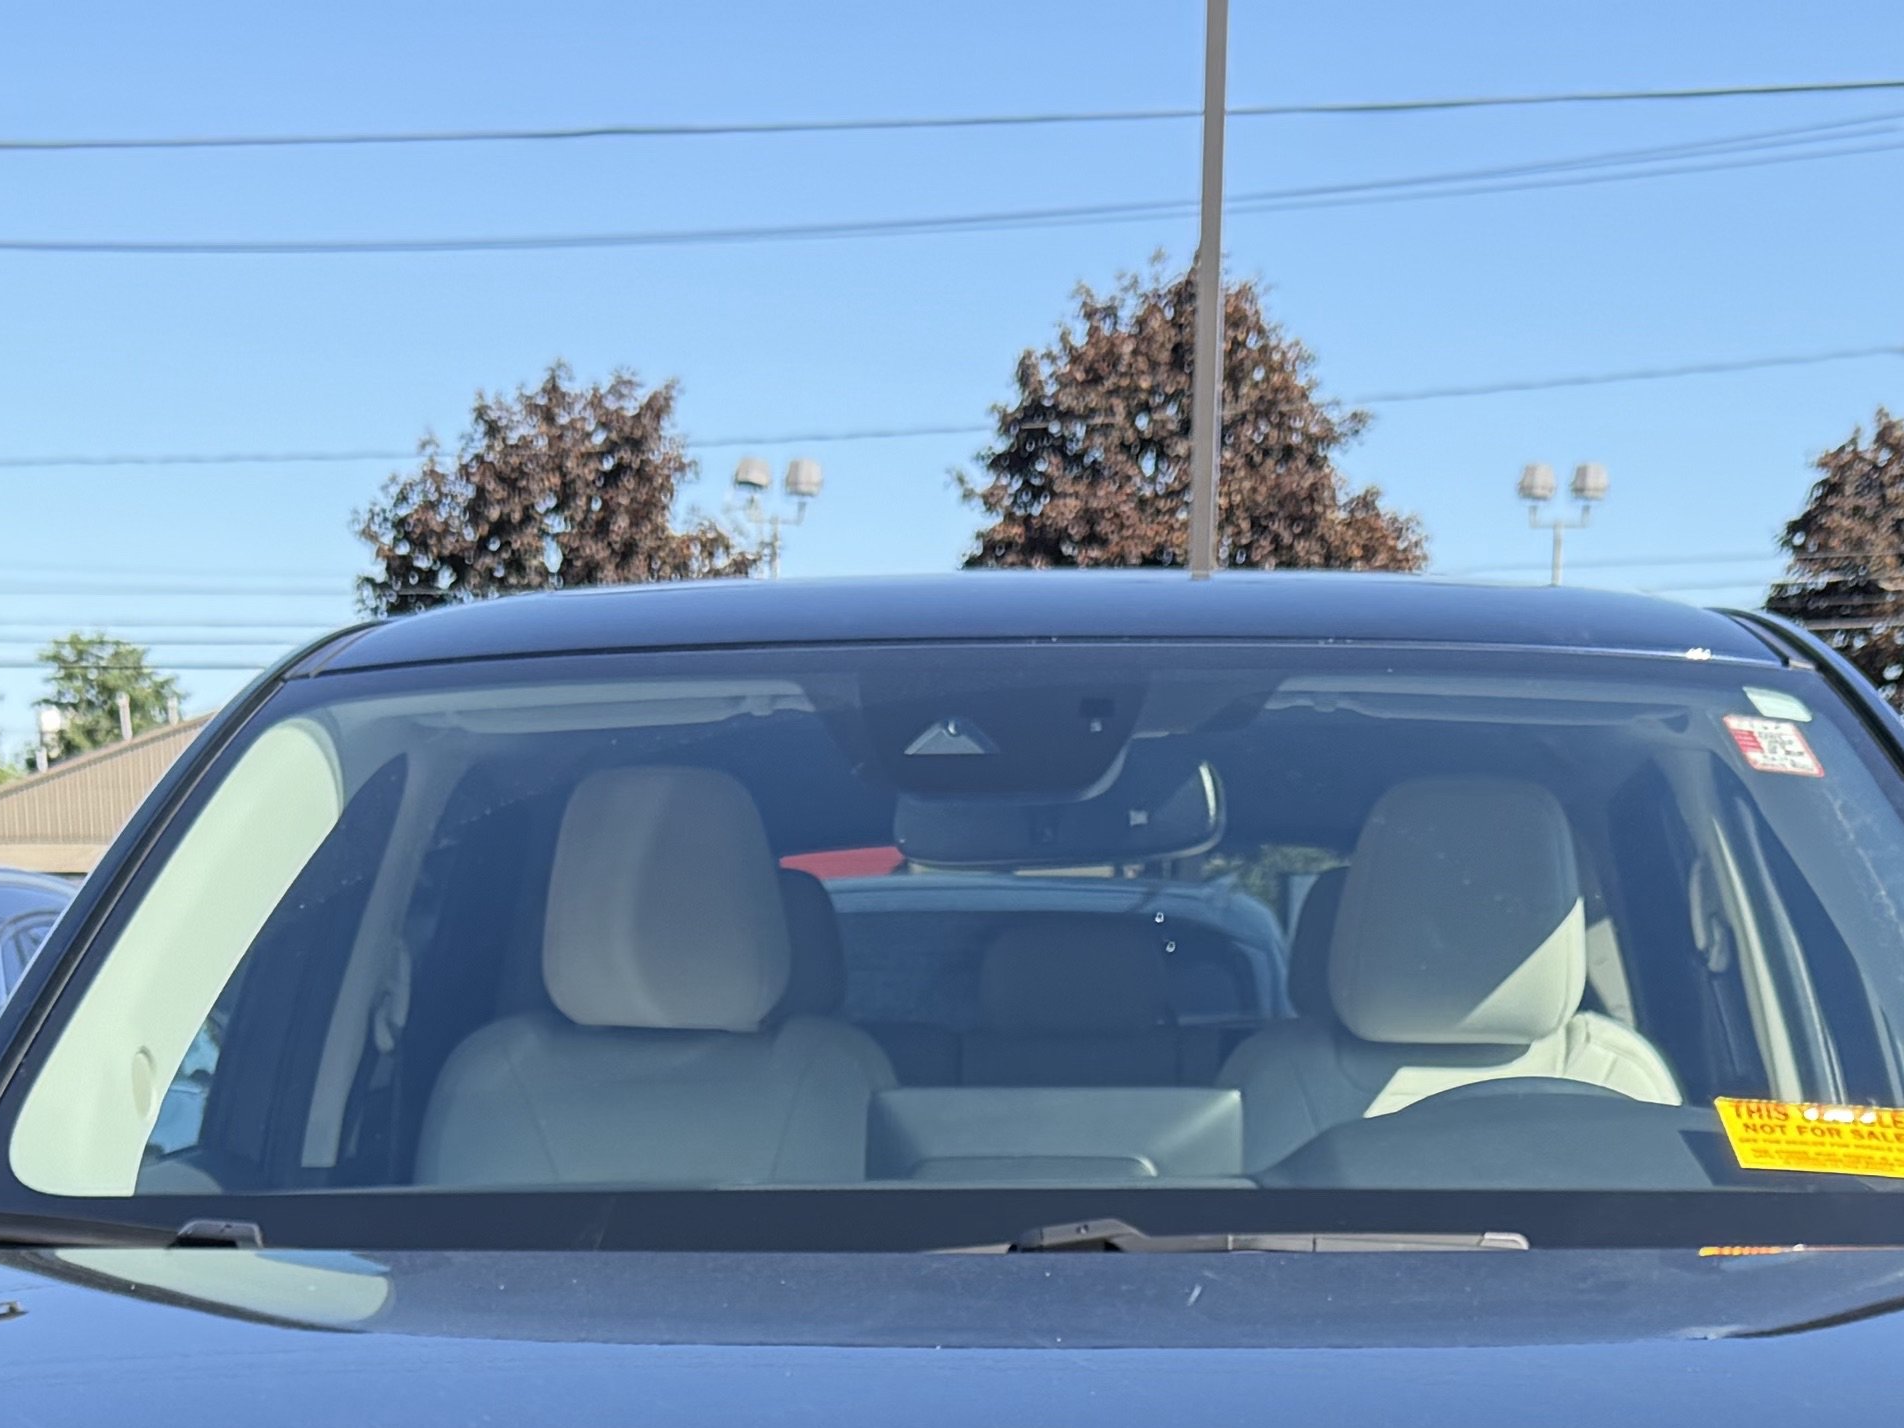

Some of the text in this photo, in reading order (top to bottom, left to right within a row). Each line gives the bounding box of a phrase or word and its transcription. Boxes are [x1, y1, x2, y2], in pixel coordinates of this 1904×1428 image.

[1734, 1102, 1789, 1122] THIS
[1743, 1122, 1787, 1136] NOT
[1796, 1125, 1841, 1139] FOR
